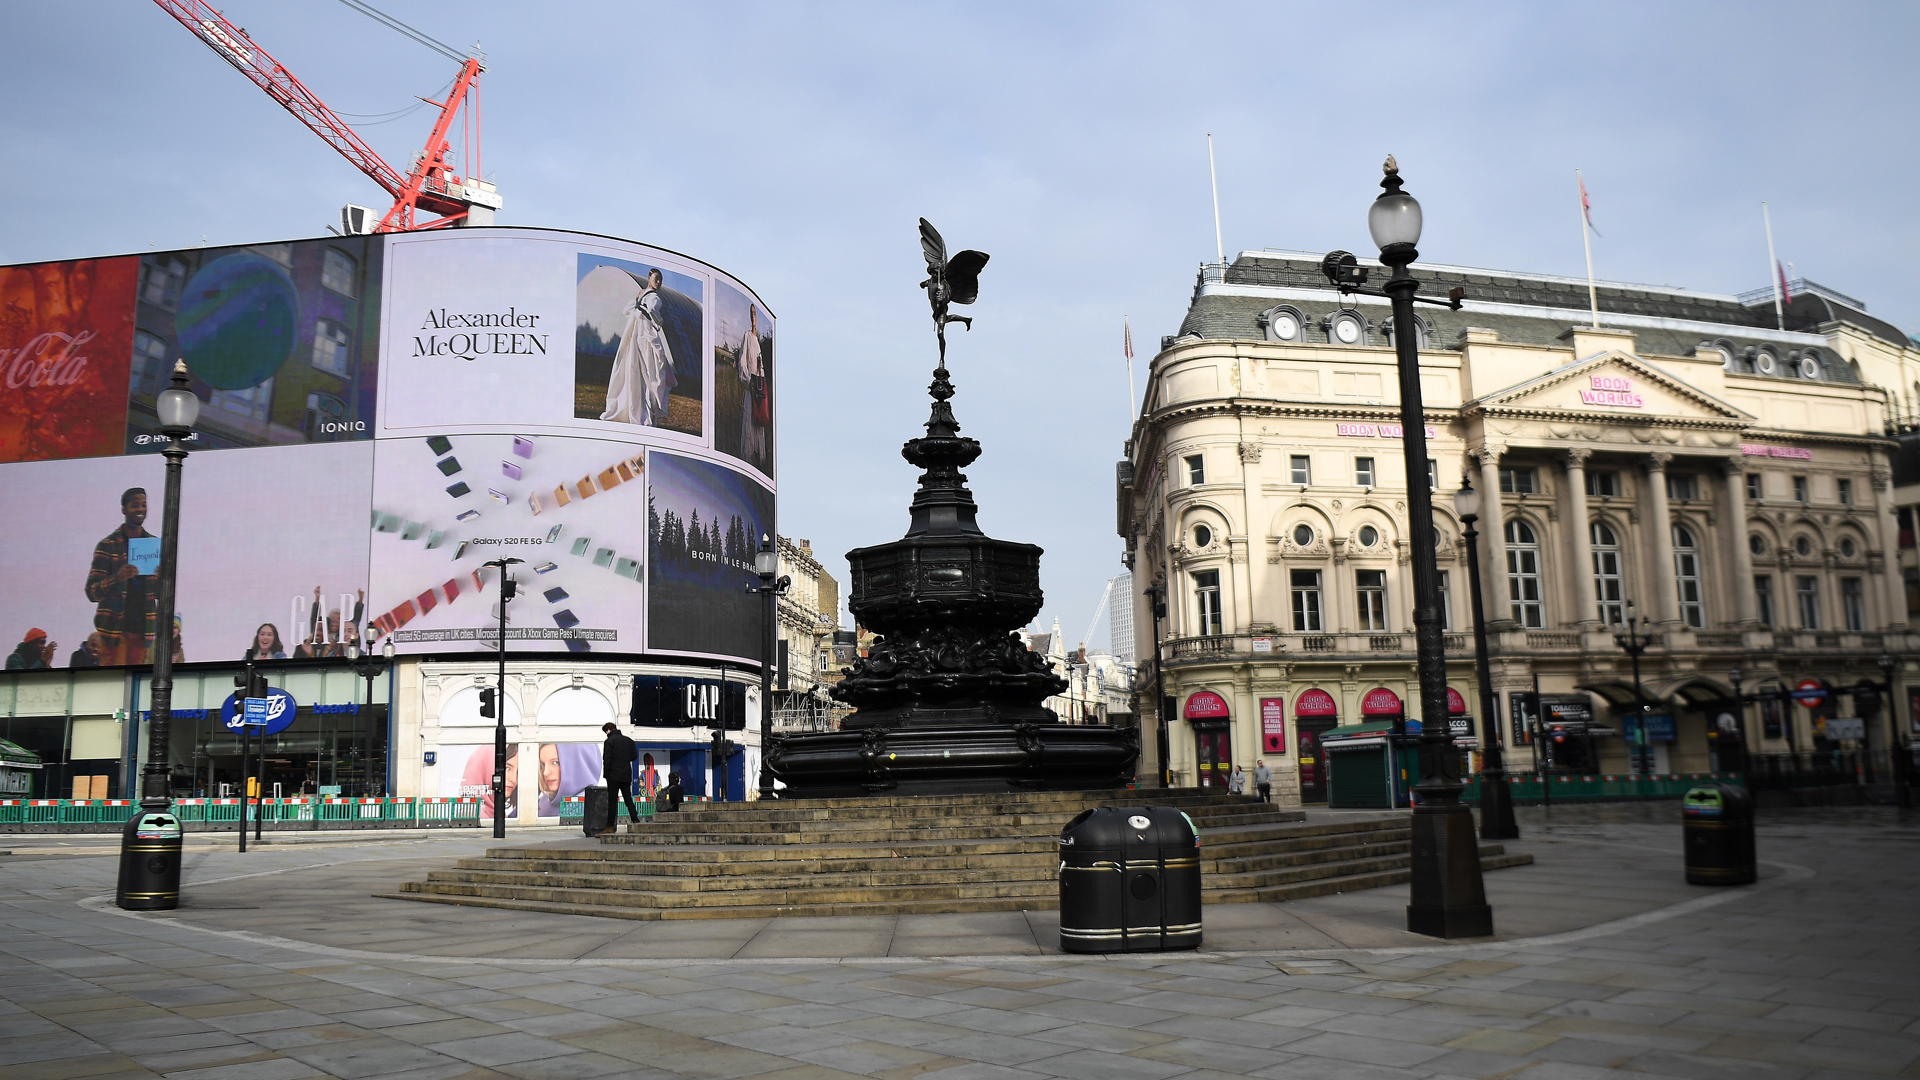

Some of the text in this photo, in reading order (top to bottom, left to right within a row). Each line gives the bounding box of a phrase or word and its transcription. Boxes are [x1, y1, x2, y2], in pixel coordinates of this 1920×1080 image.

[420, 306, 540, 330] Alexander
[412, 332, 549, 361] McQUEEN
[1592, 376, 1631, 392] BODY
[1580, 391, 1643, 407] WORLDS
[320, 420, 366, 433] IONIQ
[1338, 423, 1436, 439] BODY WOS
[472, 537, 502, 547] Galaxy
[504, 537, 519, 545] S20
[520, 537, 529, 545] FE
[691, 550, 717, 563] BORN
[720, 555, 729, 566] IN
[731, 558, 740, 568] LE
[290, 593, 354, 646] GAP
[413, 630, 421, 640] 5G
[422, 631, 444, 641] coverage
[445, 630, 450, 639] in
[451, 629, 460, 639] UK
[505, 629, 522, 639] ccount
[522, 629, 526, 639] &
[528, 629, 541, 639] Xbox
[542, 629, 558, 639] Game
[560, 629, 573, 639] Pass
[312, 701, 360, 716] beauty
[686, 683, 719, 719] GAP
[1189, 703, 1220, 711] WORLDS
[1299, 702, 1332, 710] WORLDS
